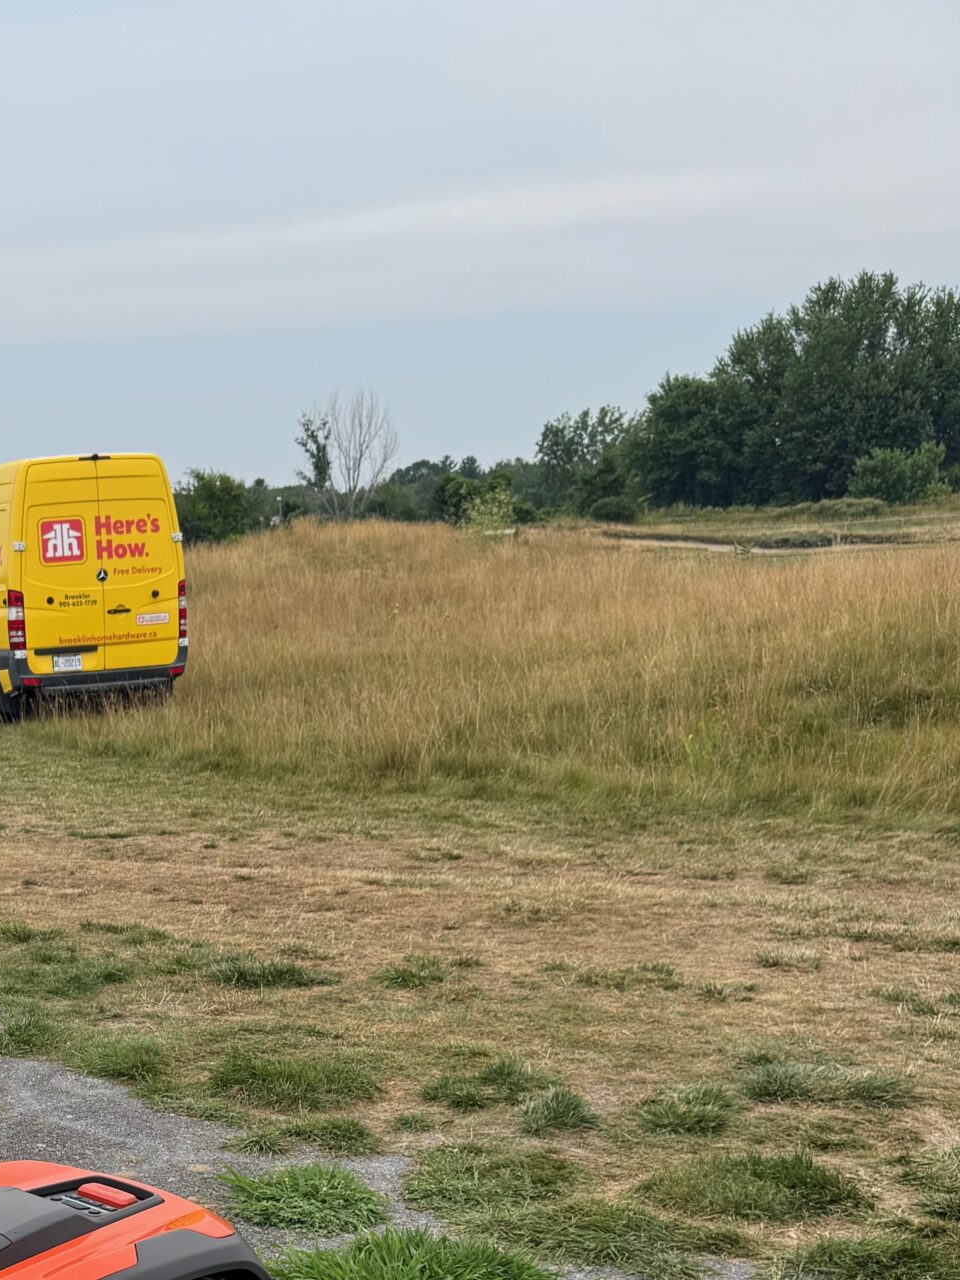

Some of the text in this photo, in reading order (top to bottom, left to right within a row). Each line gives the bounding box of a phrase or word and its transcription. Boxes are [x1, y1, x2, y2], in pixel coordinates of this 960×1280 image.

[94, 513, 160, 536] Here's
[96, 538, 149, 560] How.
[113, 565, 163, 576] Free Delivery
[64, 592, 91, 601] Brooklin
[58, 631, 157, 645] brooklinhomehardware.ca
